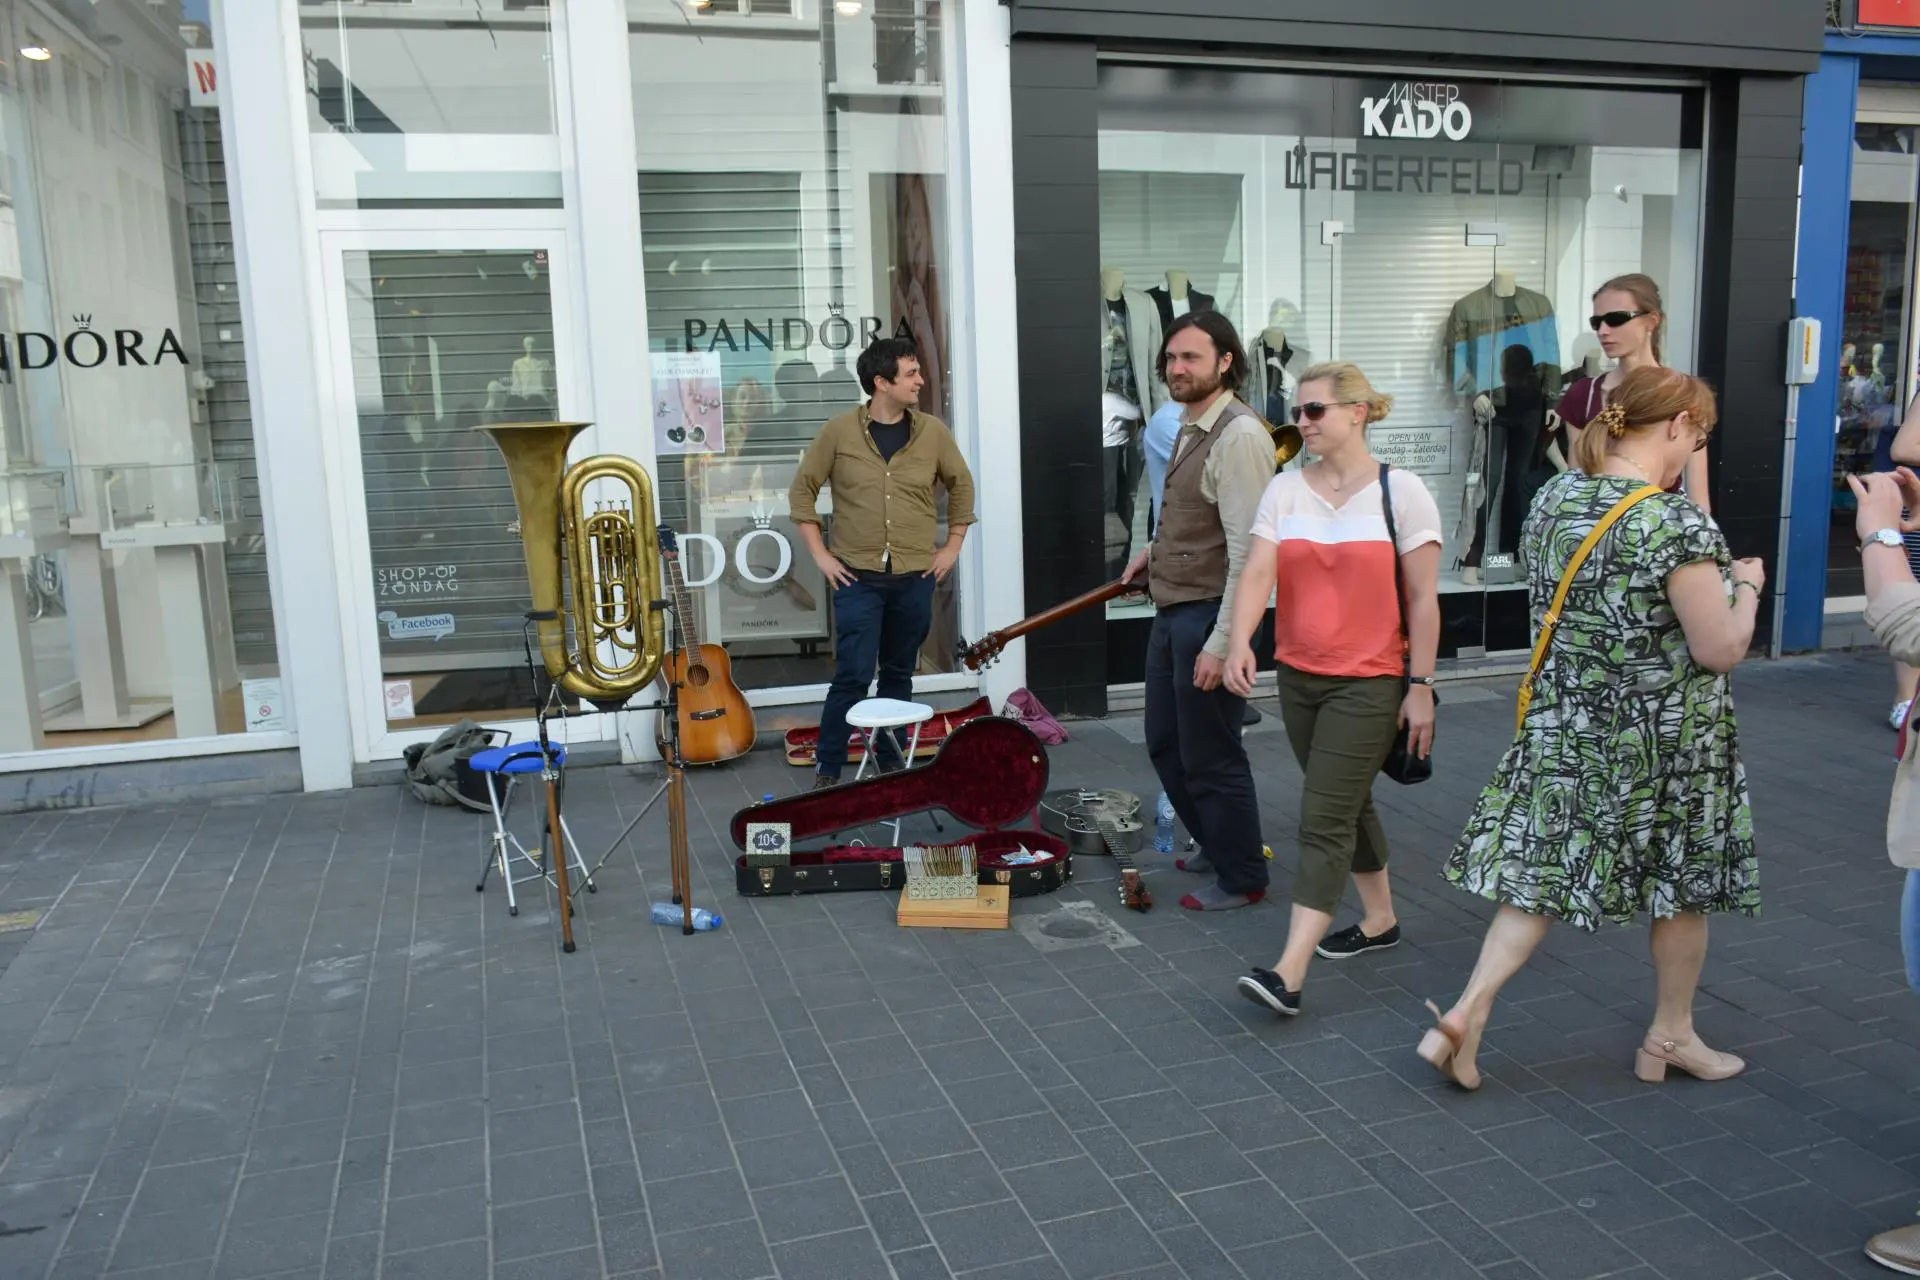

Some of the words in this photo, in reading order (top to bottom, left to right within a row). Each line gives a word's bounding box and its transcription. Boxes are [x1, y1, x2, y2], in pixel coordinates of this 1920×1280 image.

[1384, 81, 1460, 107] MISTER
[1360, 97, 1472, 141] KADO
[1285, 148, 1524, 196] LAGERFELD
[684, 315, 916, 352] PANDORA
[0, 328, 190, 370] DORA
[1388, 433, 1411, 442] OPEN
[1414, 432, 1431, 441] VAN
[1413, 443, 1447, 455] Zaterdag
[1487, 555, 1512, 564] KARL
[378, 565, 457, 582] SHOP-OP
[379, 579, 459, 595] ZONDAG
[402, 616, 452, 629] Facebook
[757, 833, 780, 846] 10€
